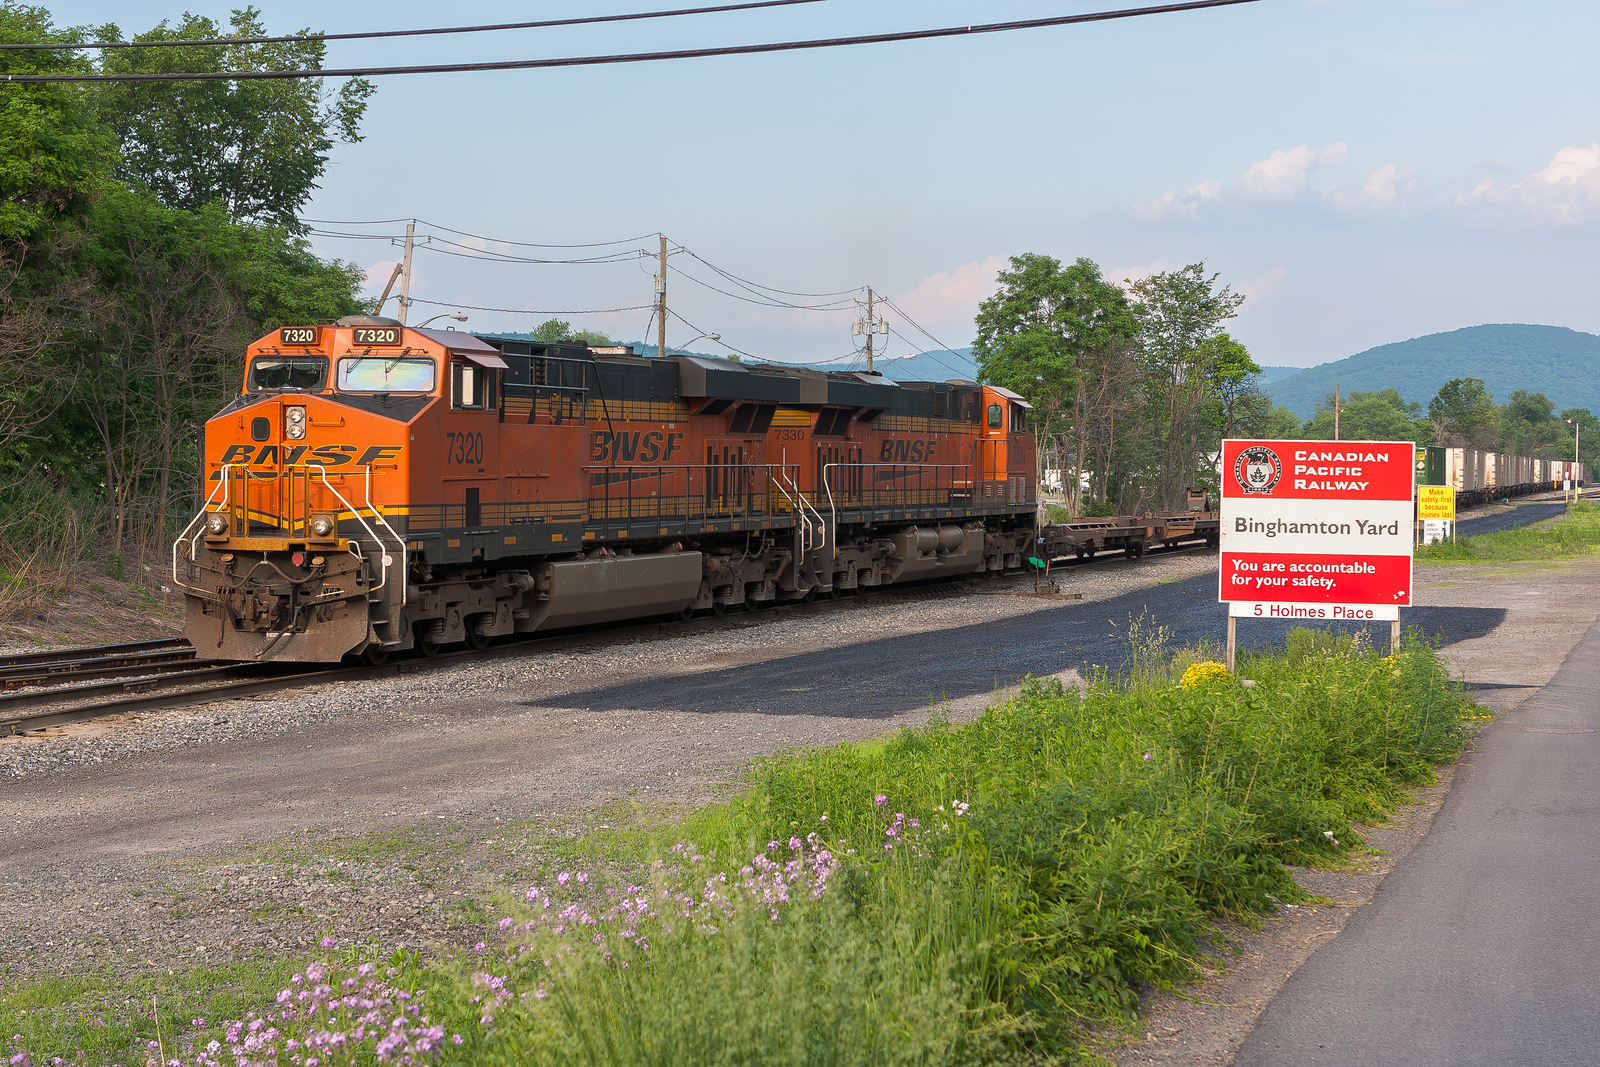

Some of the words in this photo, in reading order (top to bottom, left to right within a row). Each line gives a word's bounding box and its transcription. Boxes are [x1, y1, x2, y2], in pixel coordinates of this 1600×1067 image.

[283, 329, 314, 342] 7320
[357, 329, 395, 342] 7320
[774, 429, 805, 441] 7330
[446, 431, 484, 465] 7320
[590, 430, 685, 464] BNSF
[879, 438, 937, 464] BNSF
[220, 444, 404, 467] BNSF
[1294, 450, 1389, 463] CANADIAN
[1294, 465, 1362, 477] PACIFIC
[1294, 479, 1370, 491] RAILWAY
[1421, 496, 1438, 504] safety
[1235, 517, 1351, 538] Binghamton
[1355, 519, 1399, 536] Yard
[1231, 559, 1259, 572] You
[1261, 563, 1286, 572] are
[1289, 561, 1376, 574] accountable
[1231, 573, 1253, 586] for
[1256, 577, 1288, 589] your
[1291, 575, 1337, 590] safety.
[1253, 604, 1263, 616] 5
[1270, 605, 1326, 618] Holmes
[1333, 606, 1374, 619] Place
